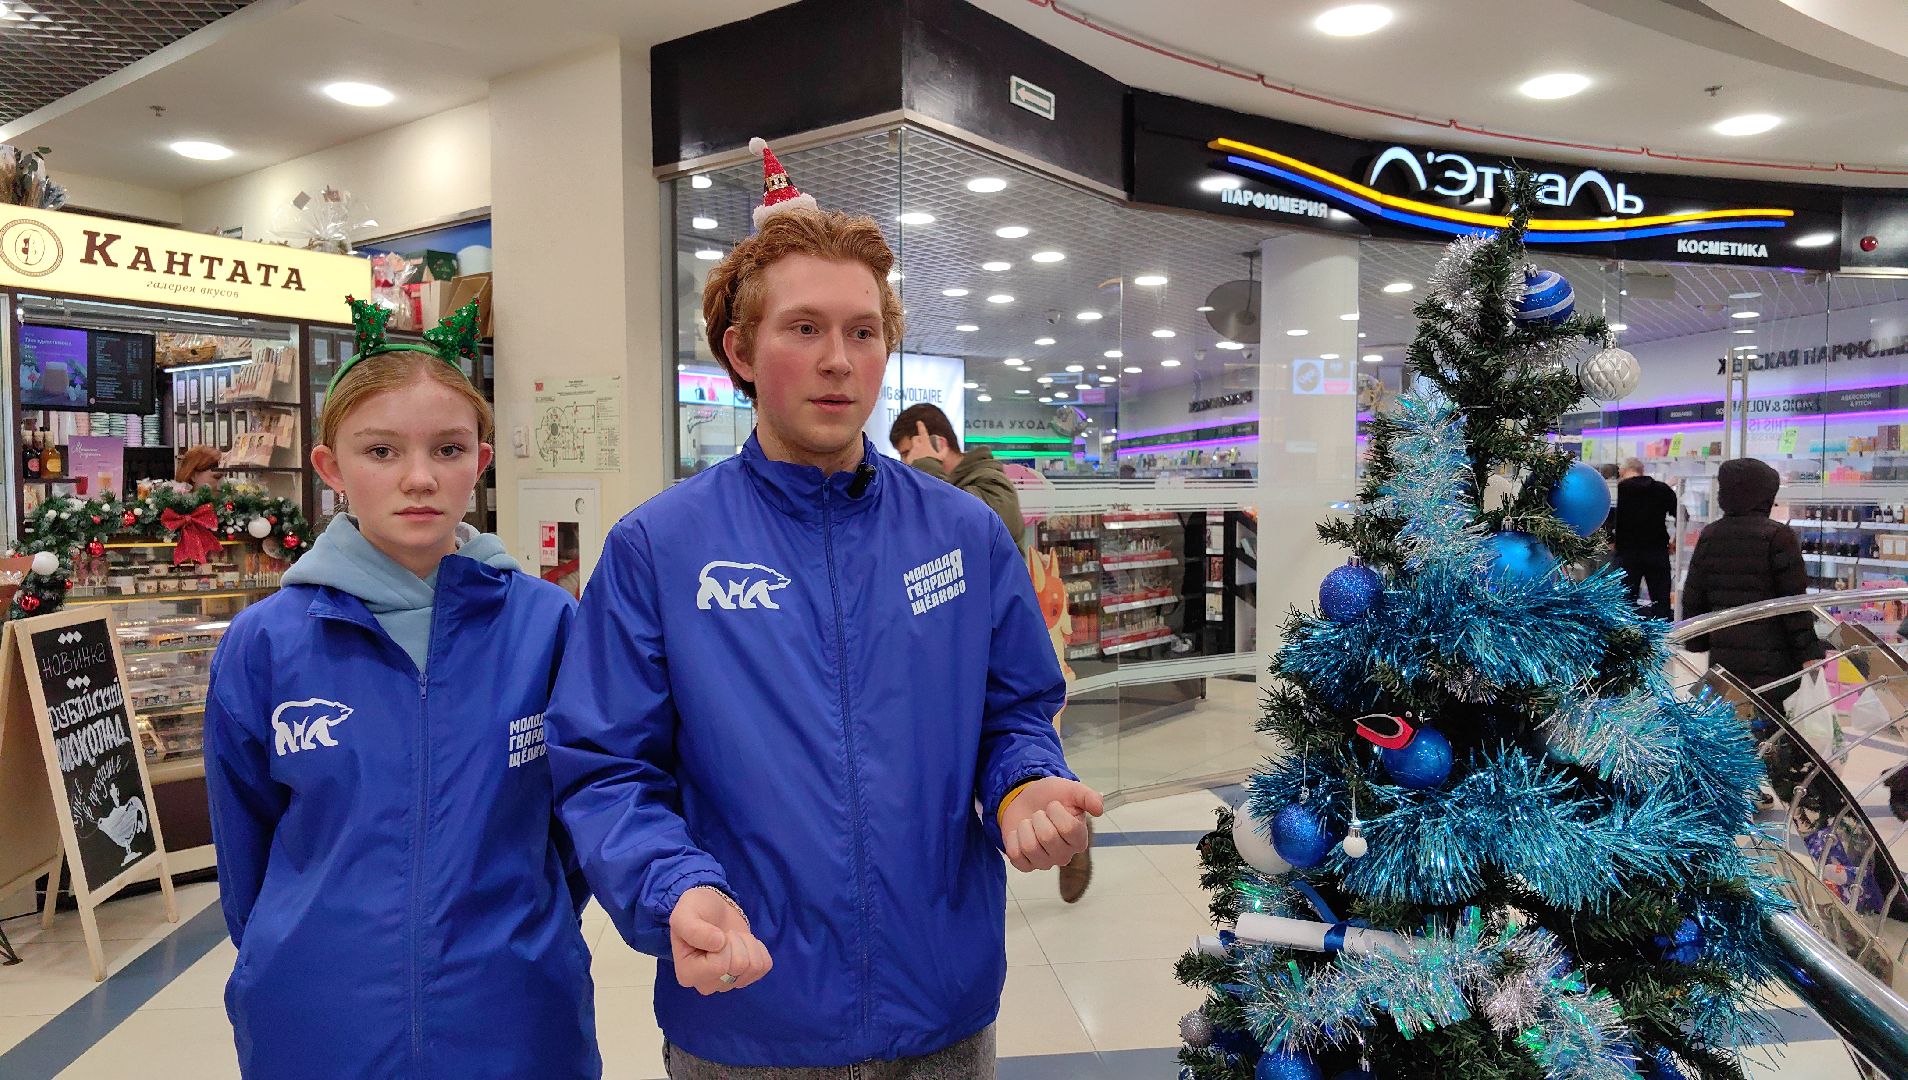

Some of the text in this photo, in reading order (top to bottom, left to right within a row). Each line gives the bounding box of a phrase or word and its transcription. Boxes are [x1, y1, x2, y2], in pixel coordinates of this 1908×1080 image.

[1221, 188, 1328, 218] ПАРФЮМЕРИЯ
[1677, 239, 1768, 258] КОСМЕТИКА
[146, 280, 240, 299] галерея вкусов
[904, 549, 963, 586] МОЛОДАЯ
[911, 580, 966, 615] ЩЁЛКОВО
[56, 714, 131, 772] ШОКОЛАД
